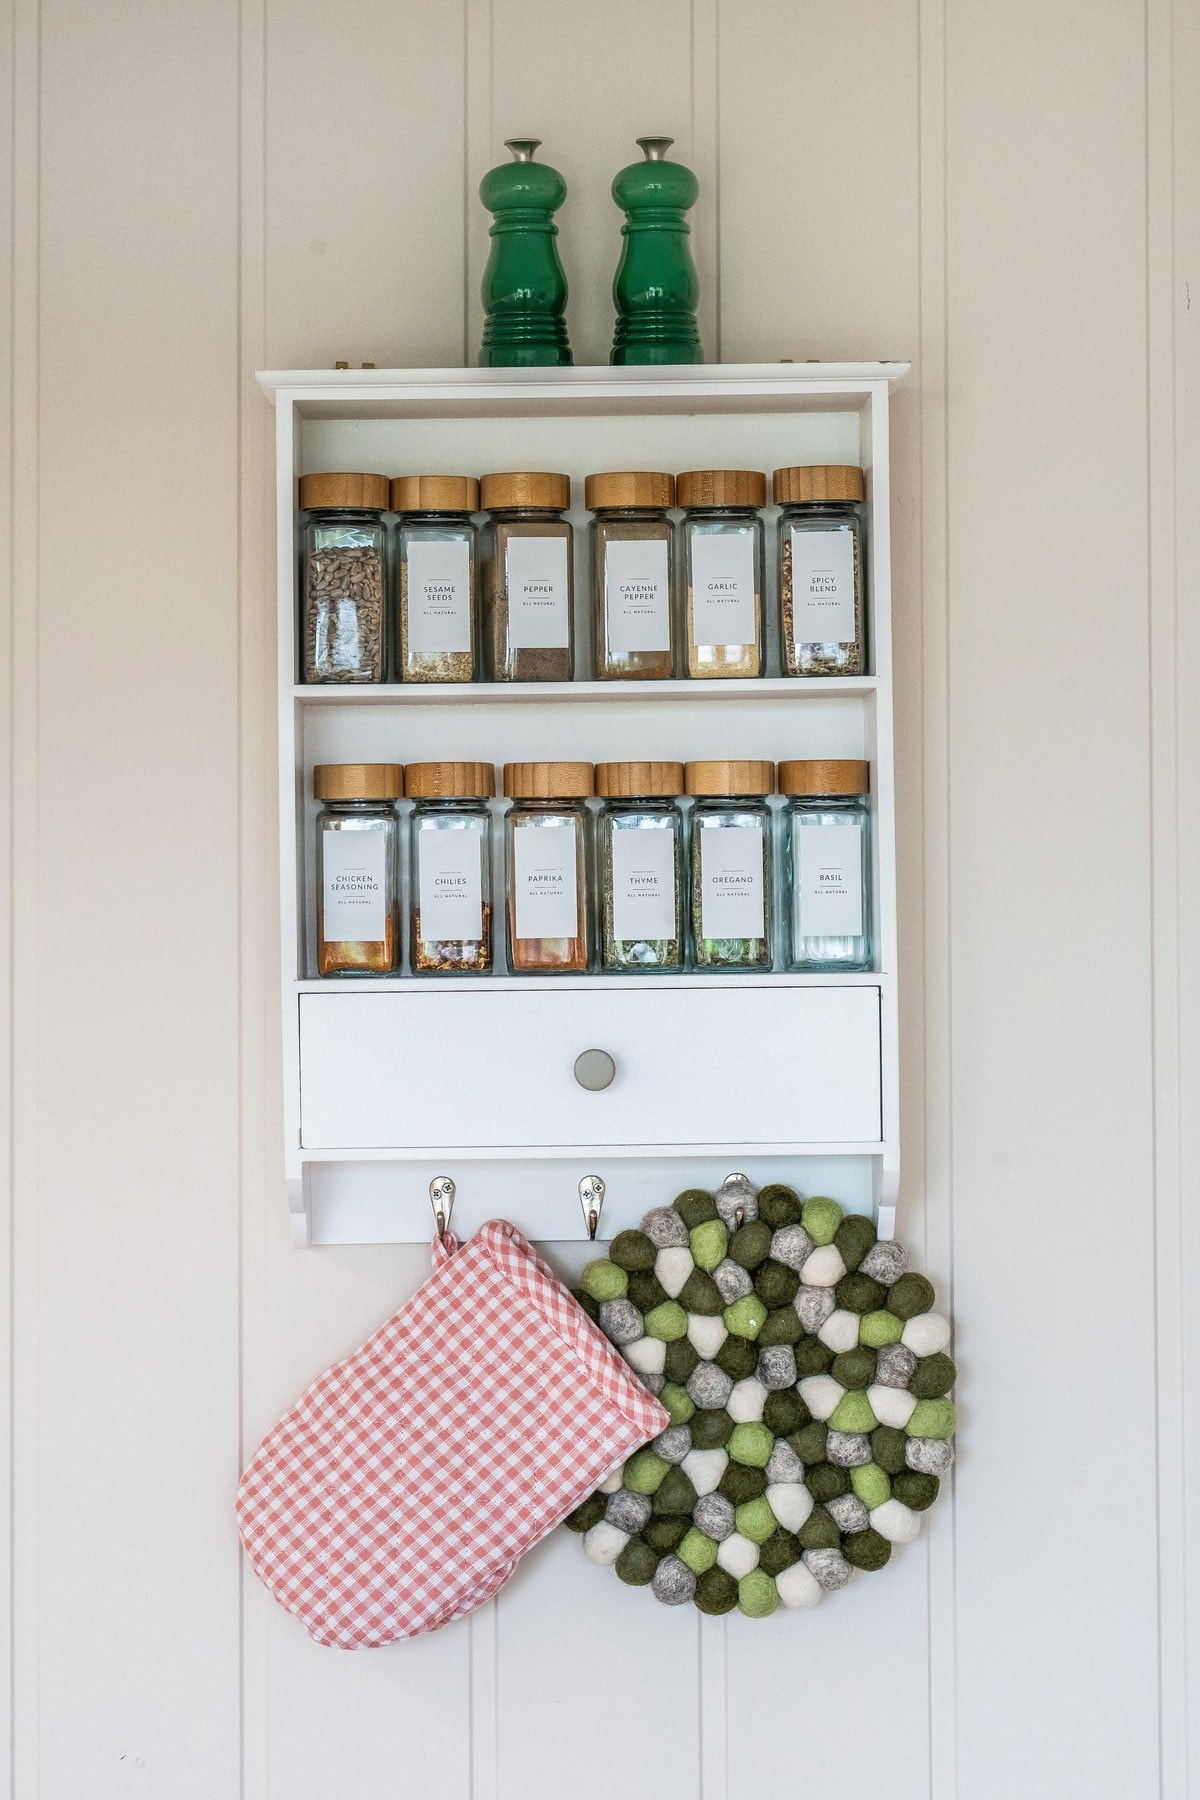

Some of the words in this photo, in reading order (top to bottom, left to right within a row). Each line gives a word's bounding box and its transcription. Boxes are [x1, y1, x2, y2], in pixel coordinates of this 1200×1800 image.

[523, 585, 554, 593] PEPPER
[809, 585, 838, 593] BLEND
[712, 876, 754, 884] OREGANO
[330, 883, 379, 891] SEASONING
